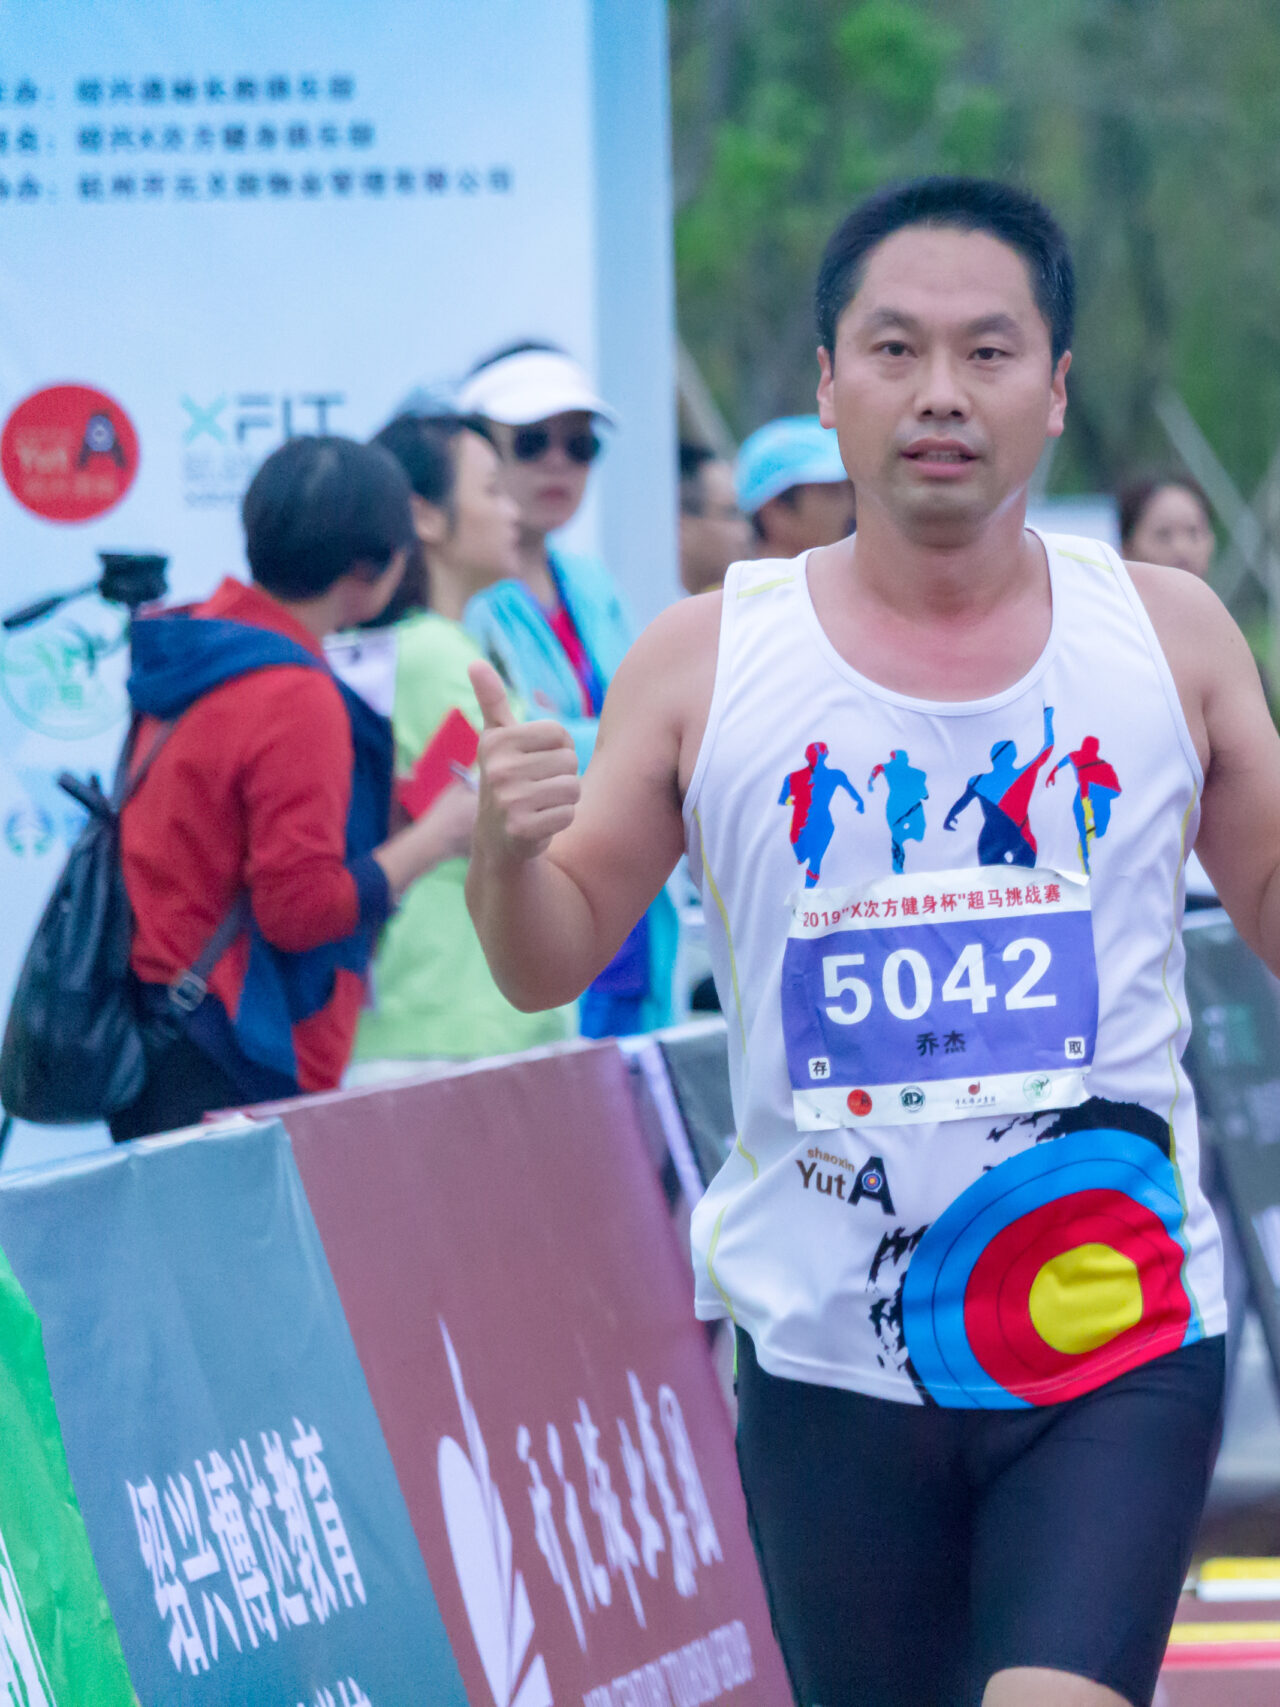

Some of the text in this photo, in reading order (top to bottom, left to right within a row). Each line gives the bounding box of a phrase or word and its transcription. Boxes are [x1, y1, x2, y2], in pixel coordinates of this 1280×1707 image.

[822, 937, 1057, 1025] 5042
[915, 1031, 966, 1056] 乔杰
[1068, 1040, 1083, 1055] 取
[812, 1060, 828, 1076] 存
[807, 1147, 855, 1173] shaoxin
[126, 1416, 366, 1676] 绍兴博达教育
